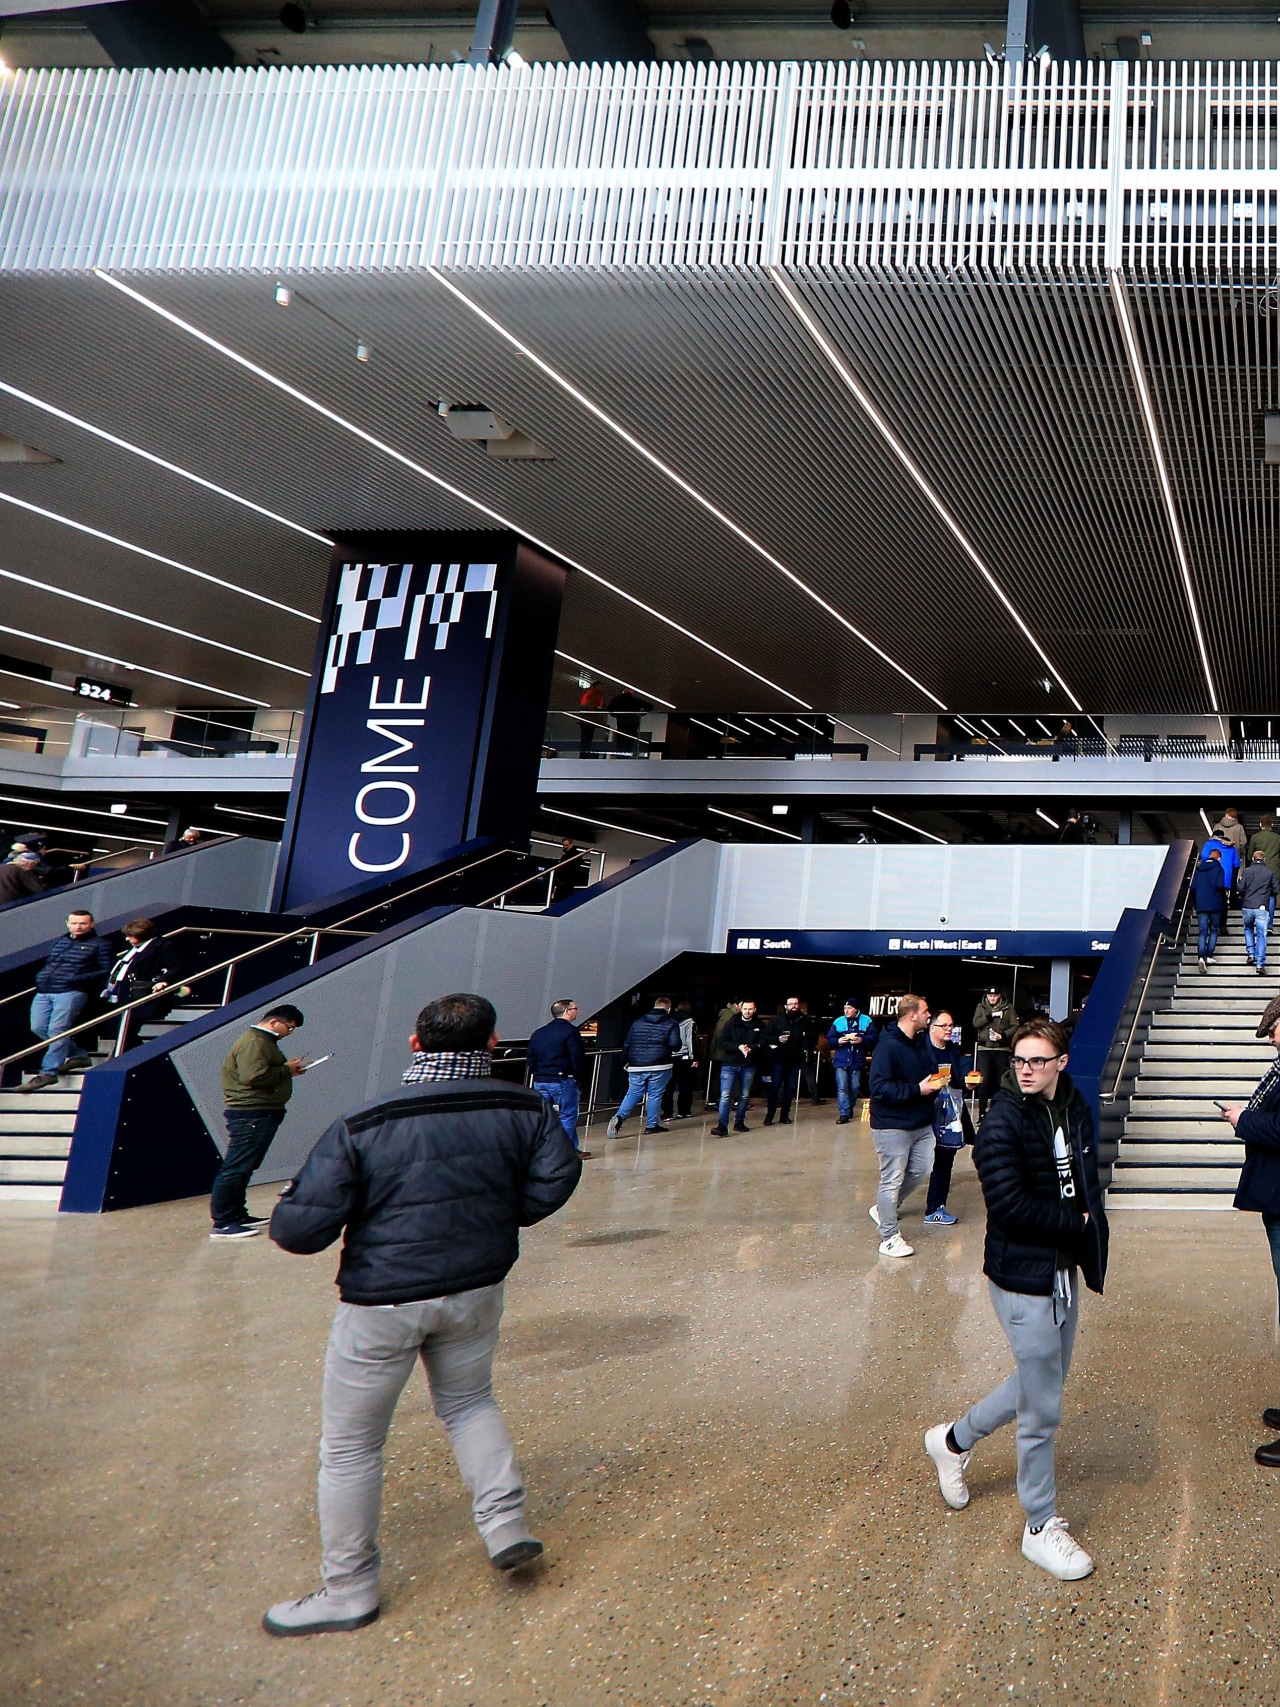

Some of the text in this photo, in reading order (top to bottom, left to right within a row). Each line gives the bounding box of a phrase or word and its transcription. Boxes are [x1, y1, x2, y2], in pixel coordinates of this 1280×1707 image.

[79, 682, 111, 701] 324
[762, 939, 791, 949] South
[1091, 940, 1111, 951] Sou
